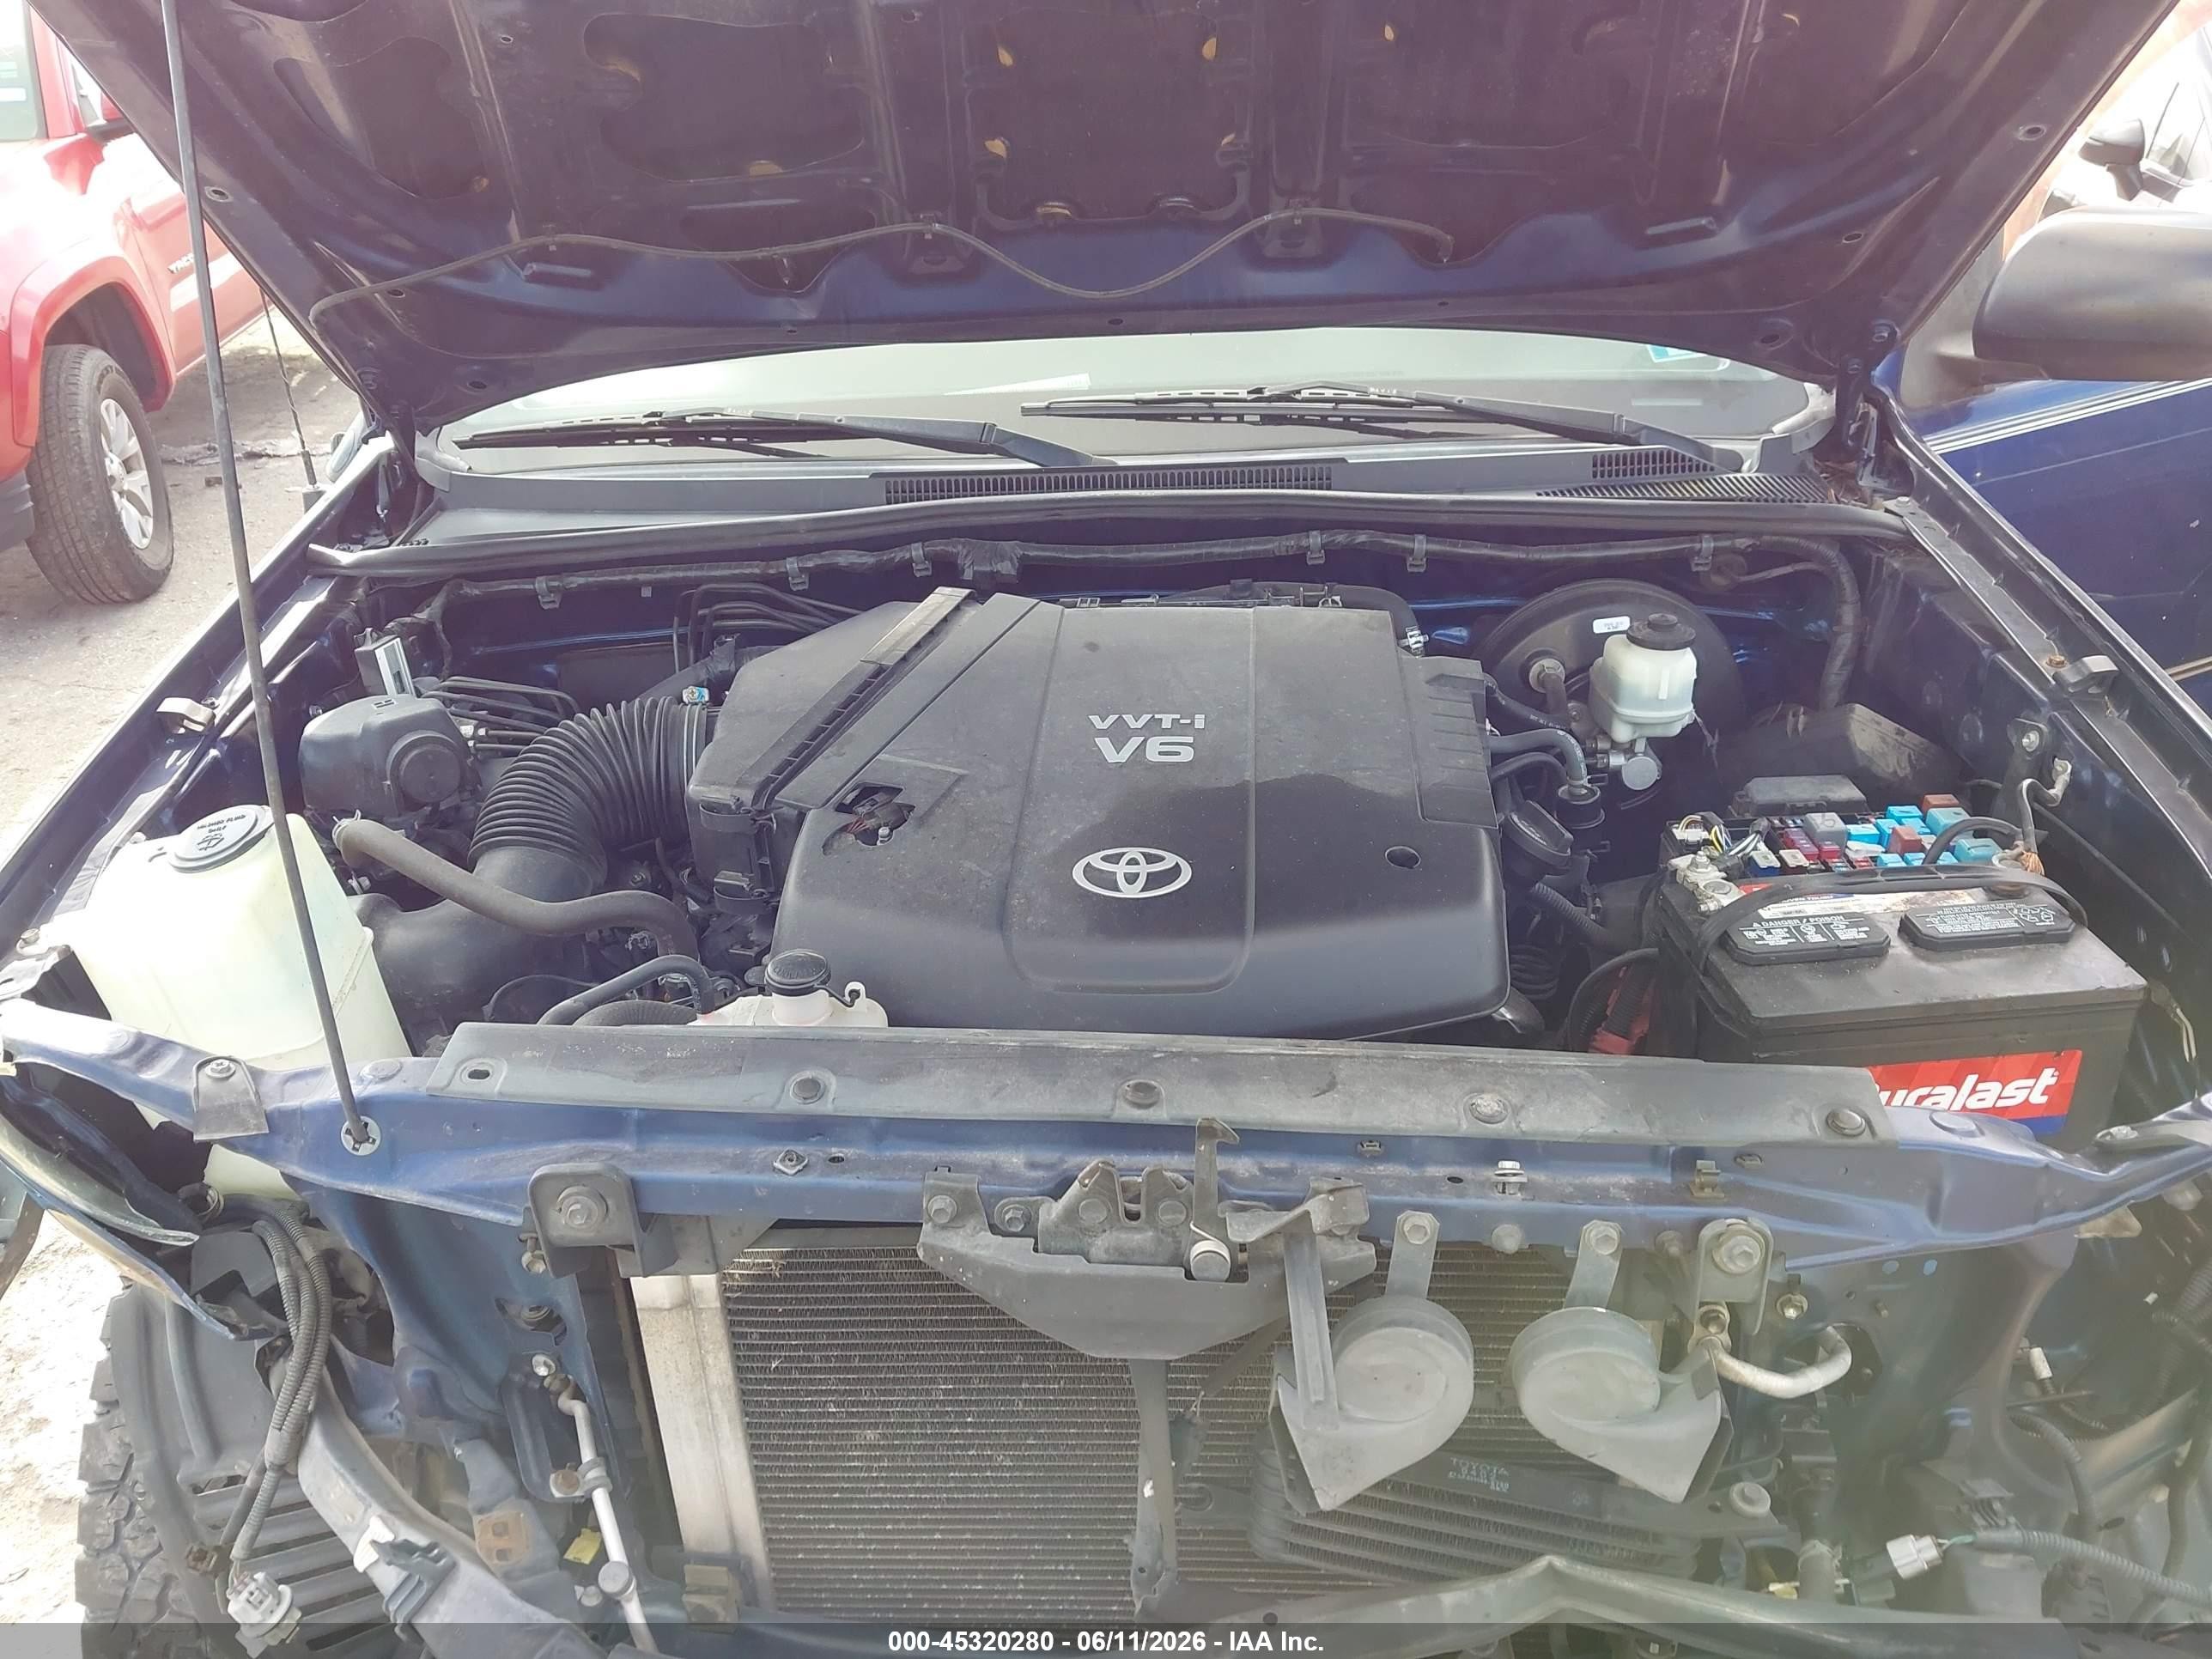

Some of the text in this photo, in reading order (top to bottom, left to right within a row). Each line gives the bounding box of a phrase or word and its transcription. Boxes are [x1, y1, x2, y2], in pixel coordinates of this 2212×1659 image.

[1088, 714, 1206, 729] VVT-i
[1094, 736, 1194, 763] V6
[1875, 1067, 2059, 1111] uralast
